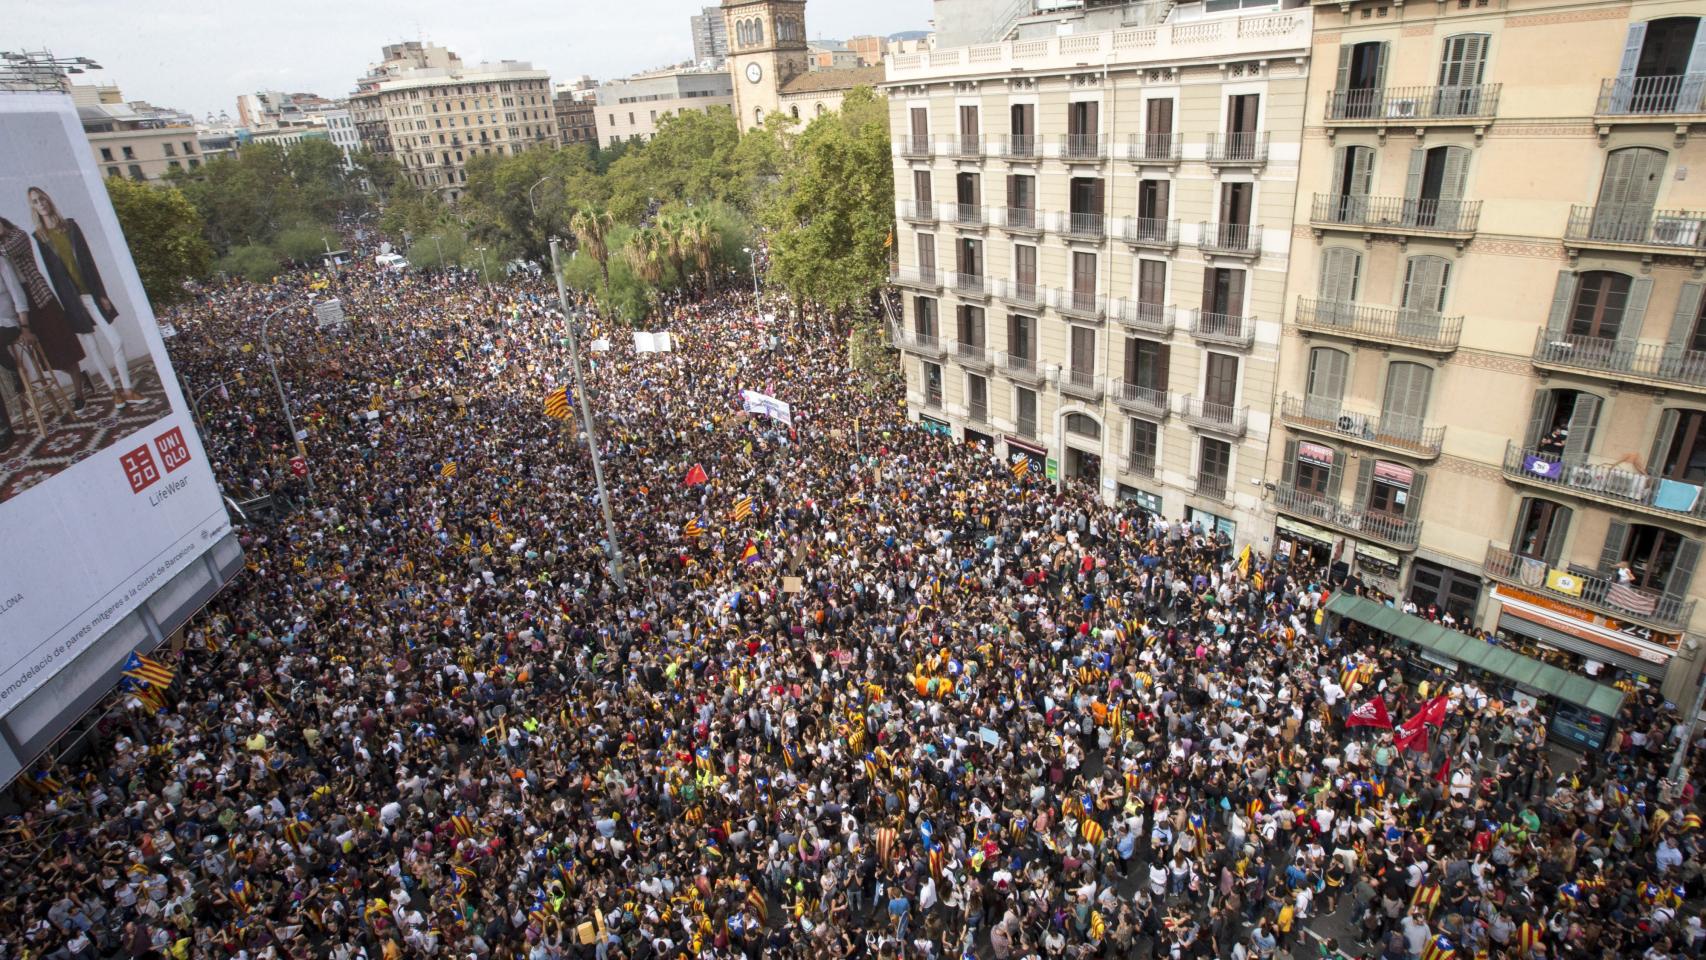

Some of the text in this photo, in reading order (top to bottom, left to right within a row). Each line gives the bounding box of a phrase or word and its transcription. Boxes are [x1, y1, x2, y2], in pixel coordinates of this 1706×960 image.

[158, 433, 180, 452] UNI
[165, 447, 186, 467] QLO
[149, 475, 189, 507] LifeWear
[0, 655, 53, 702] emodelació
[53, 644, 65, 657] de
[65, 624, 92, 649] parets
[91, 599, 124, 628] mitgeres
[136, 572, 157, 591] ciutat
[156, 566, 166, 577] de
[164, 542, 195, 569] Barcelona
